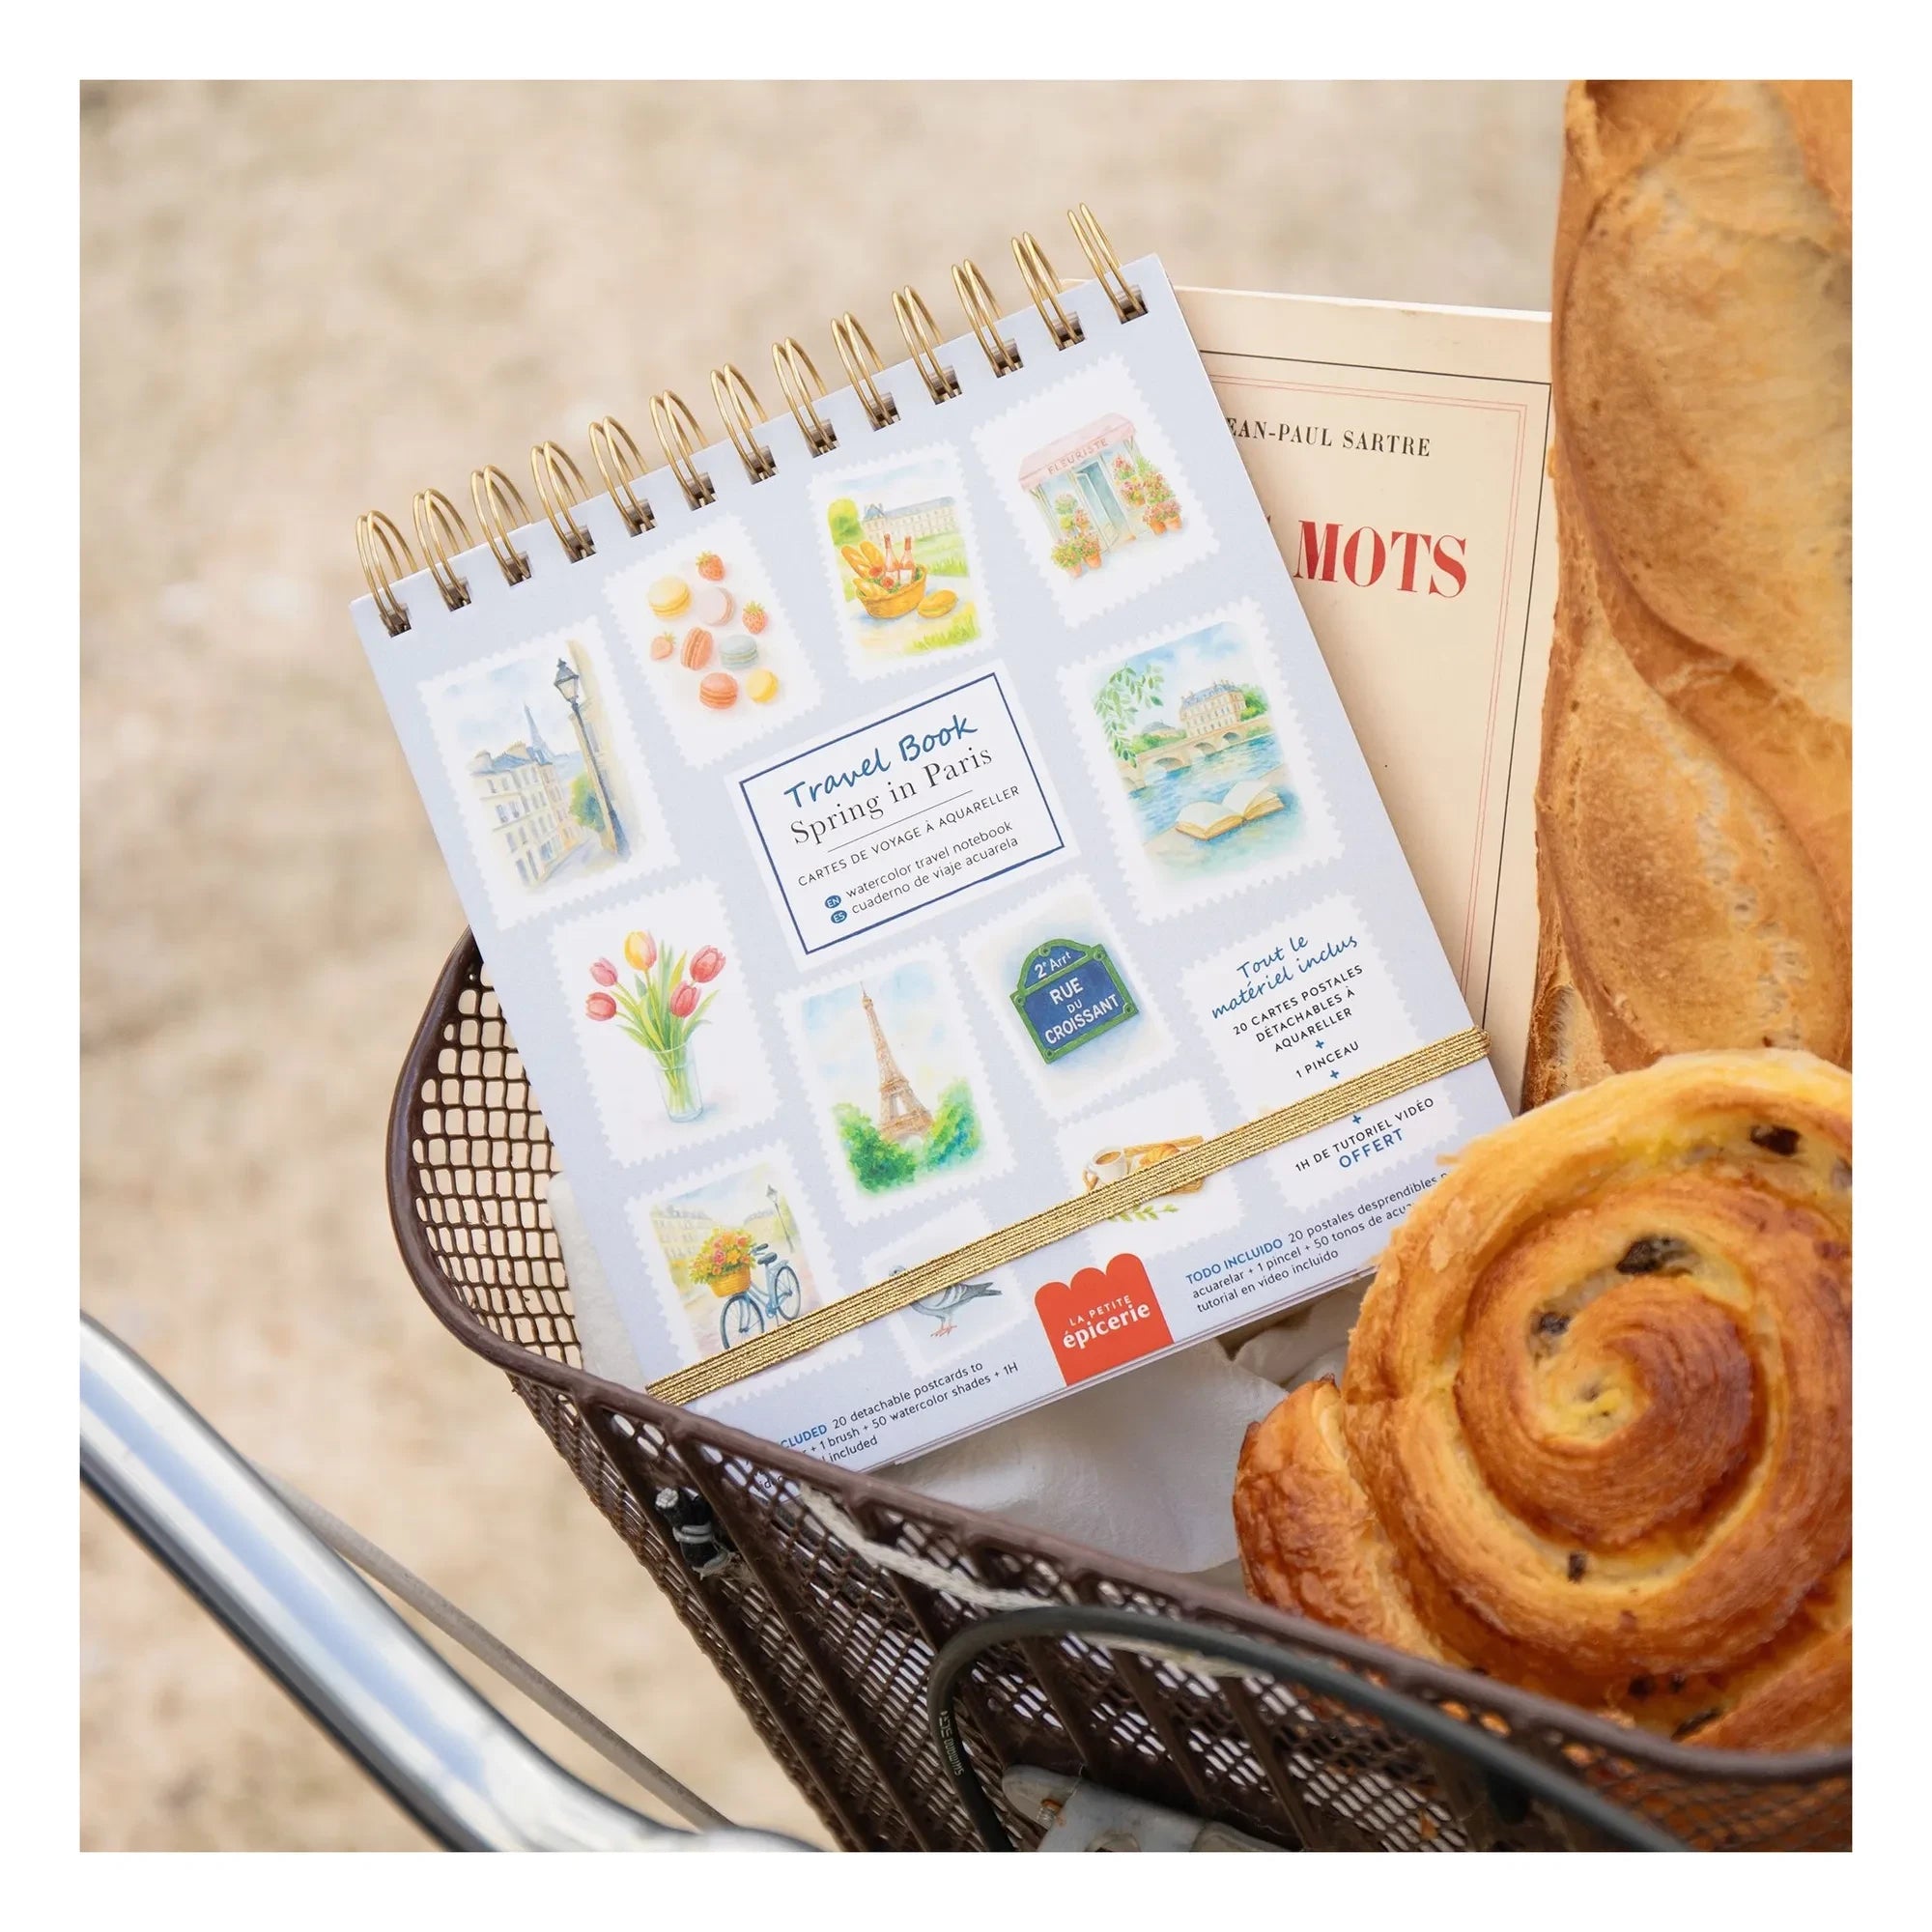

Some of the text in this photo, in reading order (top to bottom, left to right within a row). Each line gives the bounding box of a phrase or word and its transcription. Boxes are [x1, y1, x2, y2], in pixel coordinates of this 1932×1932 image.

[1224, 415, 1430, 457] EAN-PAUL SARTRE
[1291, 519, 1467, 598] MOTS
[782, 713, 979, 809] Travel Book
[789, 746, 992, 845] Spring in Paris
[797, 784, 1019, 887] CARTES DE VOYAGE À AQUARELLER
[844, 820, 1013, 897] watercolor travel notebook
[827, 895, 840, 908] EN
[850, 837, 1018, 914] cuaderno de viaje acuarela
[833, 911, 846, 923] ES
[1210, 934, 1358, 1019] matériel inclus
[1235, 935, 1309, 979] Tout le
[1044, 994, 1119, 1044] CROISSANT
[1049, 978, 1084, 1006] RUE
[1066, 1000, 1083, 1014] DU
[1232, 963, 1363, 1036] 20 CARTES POSTALES
[1254, 983, 1355, 1042] DÉTACHABLES À
[1274, 1007, 1352, 1053] AQUARELLER
[1294, 1039, 1359, 1078] 1 PINCEAU
[1294, 1096, 1434, 1172] 1H DE TUTORIEL VIDÉO
[1338, 1126, 1403, 1168] OFFERT
[1184, 1263, 1222, 1285] TODO
[1222, 1237, 1283, 1269] INCLUIDO
[1287, 1229, 1304, 1243] 20
[1305, 1209, 1354, 1238] postales
[1357, 1177, 1438, 1215] desprendibles
[1191, 1270, 1244, 1299] acuarelar
[1256, 1262, 1264, 1271] 1
[1264, 1245, 1301, 1271] pincel
[1312, 1235, 1329, 1249] 50
[1330, 1221, 1366, 1242] tonos
[1367, 1214, 1383, 1227] de
[1068, 1295, 1131, 1326] LA PETITE
[1196, 1287, 1238, 1313] tutorial
[1239, 1283, 1256, 1295] en
[1290, 1249, 1339, 1274] incluido
[1063, 1304, 1151, 1350] épicerie
[780, 1361, 983, 1449] CLUDED 20 detachable postcards to
[818, 1439, 826, 1450] 1
[826, 1427, 861, 1447] brush
[870, 1414, 887, 1430] 50
[888, 1390, 949, 1421] watercolor
[951, 1374, 991, 1397] shades
[1002, 1360, 1018, 1376] 1H
[827, 1434, 878, 1463] included
